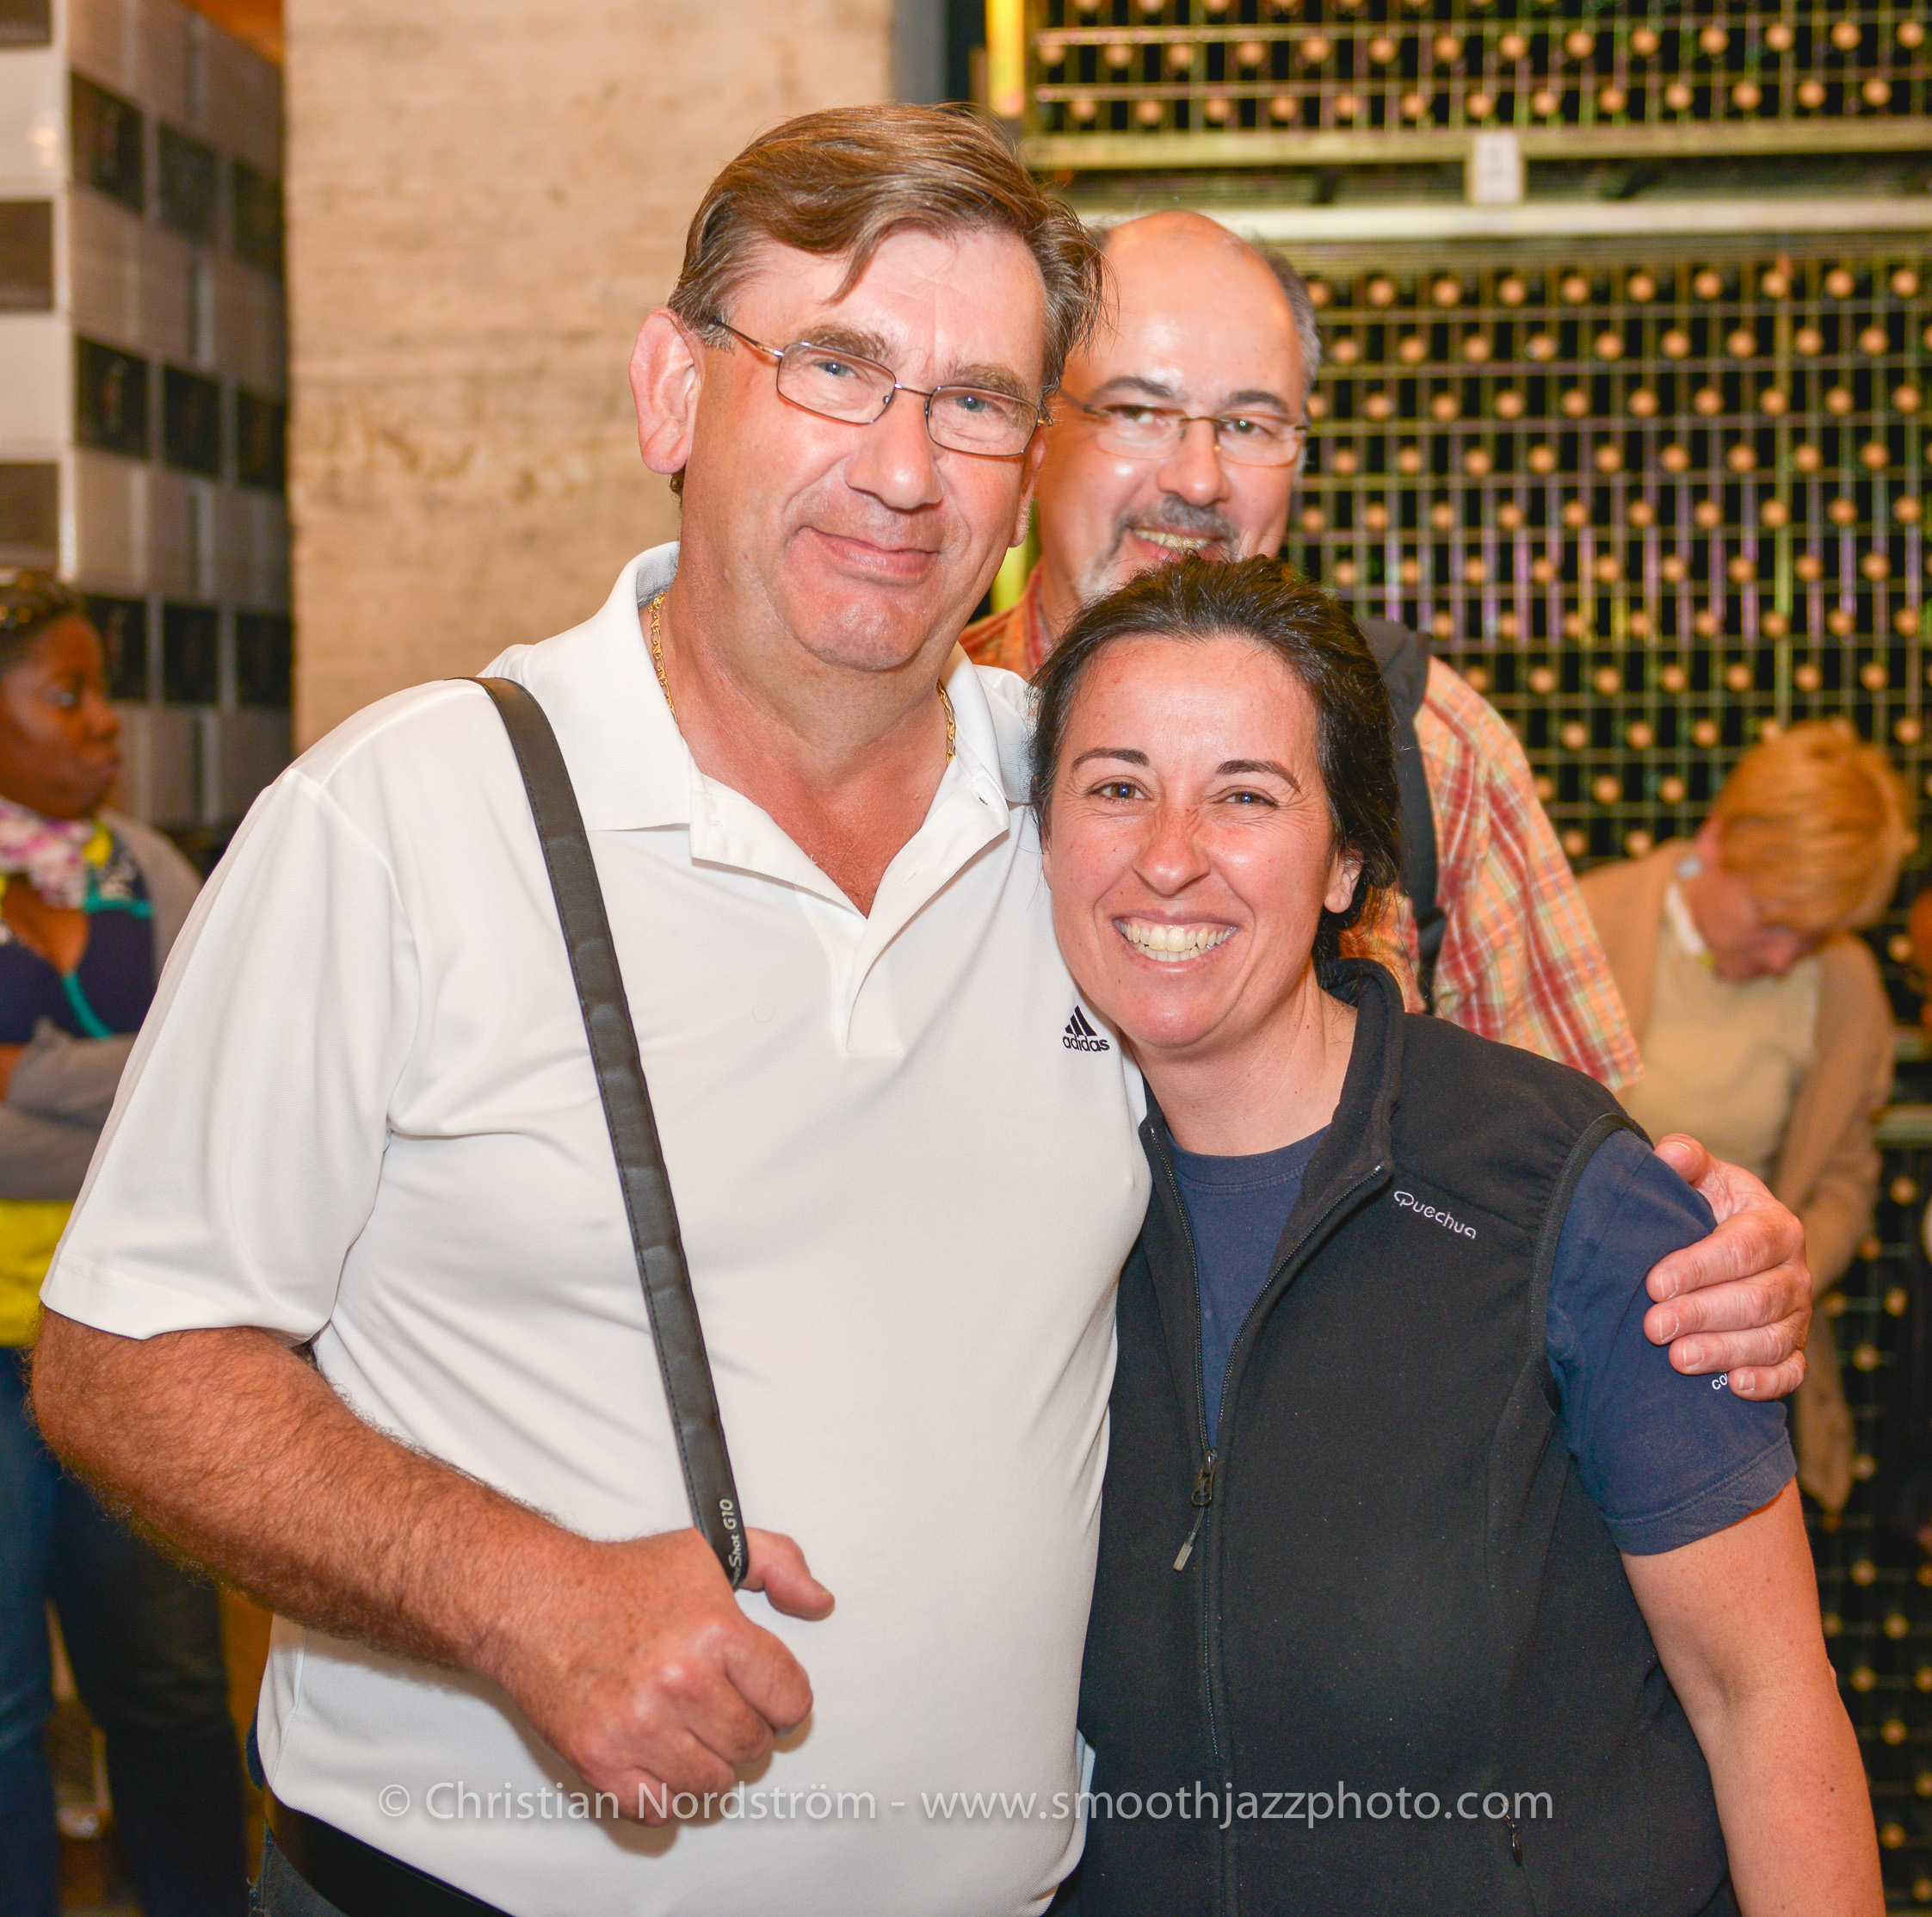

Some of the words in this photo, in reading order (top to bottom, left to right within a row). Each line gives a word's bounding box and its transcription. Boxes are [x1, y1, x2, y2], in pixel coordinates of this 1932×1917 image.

[1062, 1034, 1110, 1052] adidas
[1393, 1190, 1477, 1240] Quechua
[719, 1498, 738, 1531] G10
